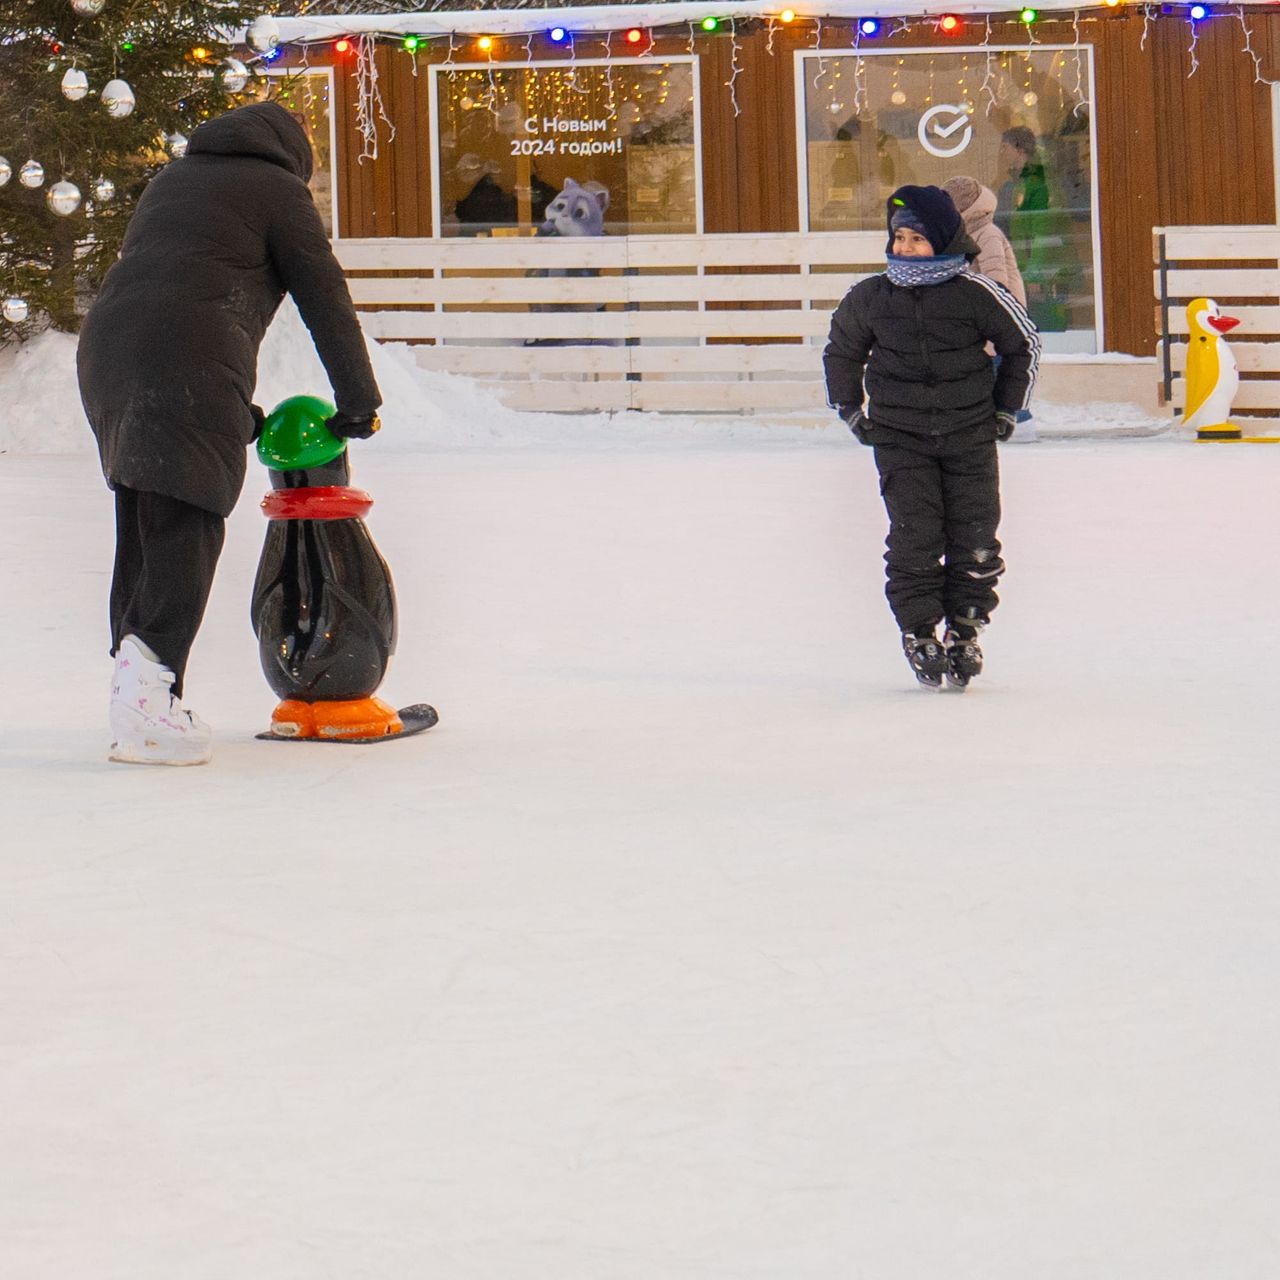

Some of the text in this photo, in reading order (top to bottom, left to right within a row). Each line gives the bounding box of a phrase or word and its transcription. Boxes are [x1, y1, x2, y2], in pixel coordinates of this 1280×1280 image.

[524, 117, 607, 132] С Новым
[510, 137, 623, 156] 2024 годом!
